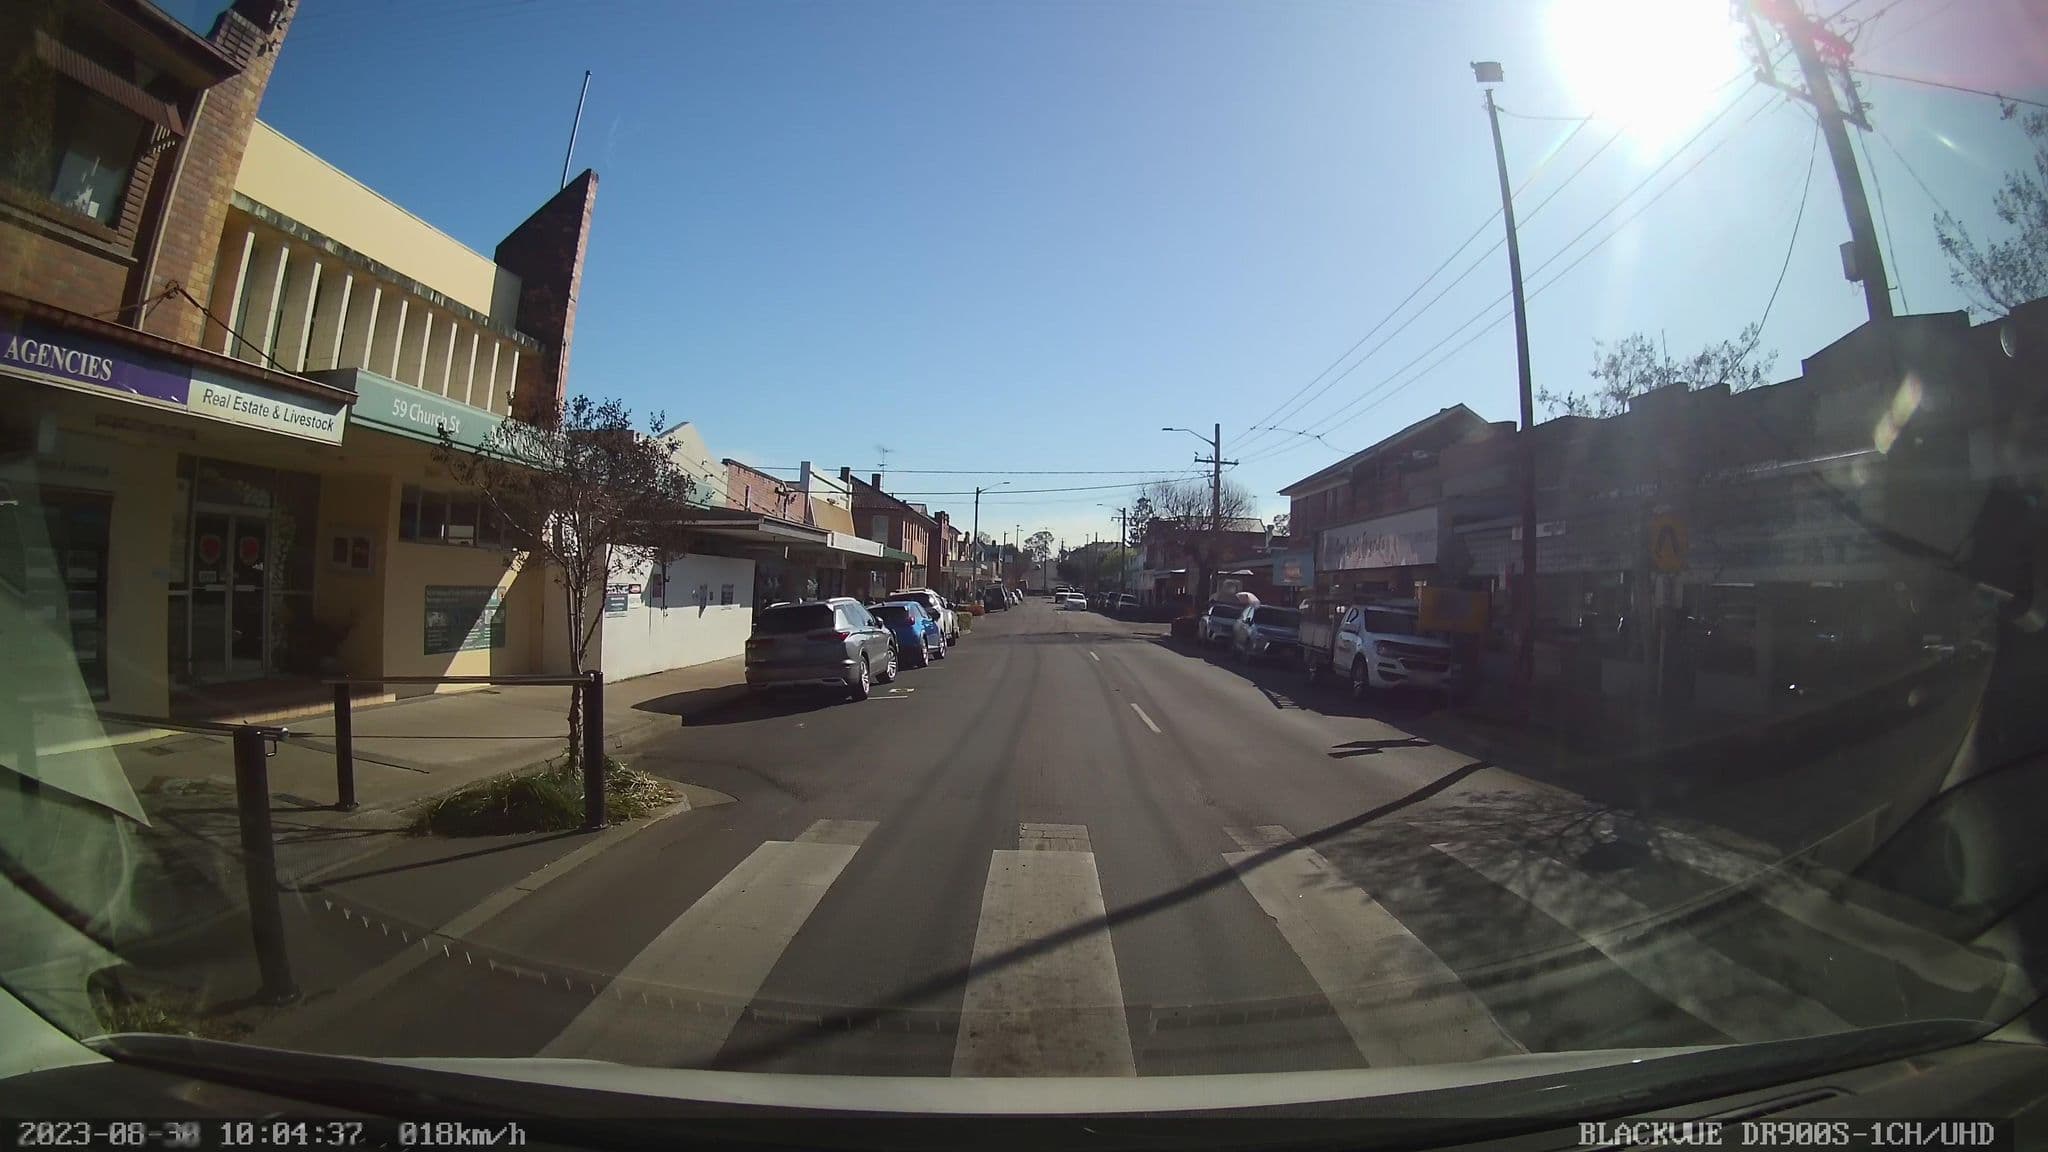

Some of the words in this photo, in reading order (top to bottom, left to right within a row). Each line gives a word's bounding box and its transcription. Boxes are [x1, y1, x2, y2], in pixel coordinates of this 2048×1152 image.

[4, 336, 113, 381] AGENCIES
[202, 388, 230, 408] Real
[233, 396, 269, 418] Estate
[272, 406, 280, 420] &
[284, 408, 335, 432] Livestock
[392, 399, 407, 418] 59
[409, 403, 448, 428] Church
[450, 415, 460, 433] St
